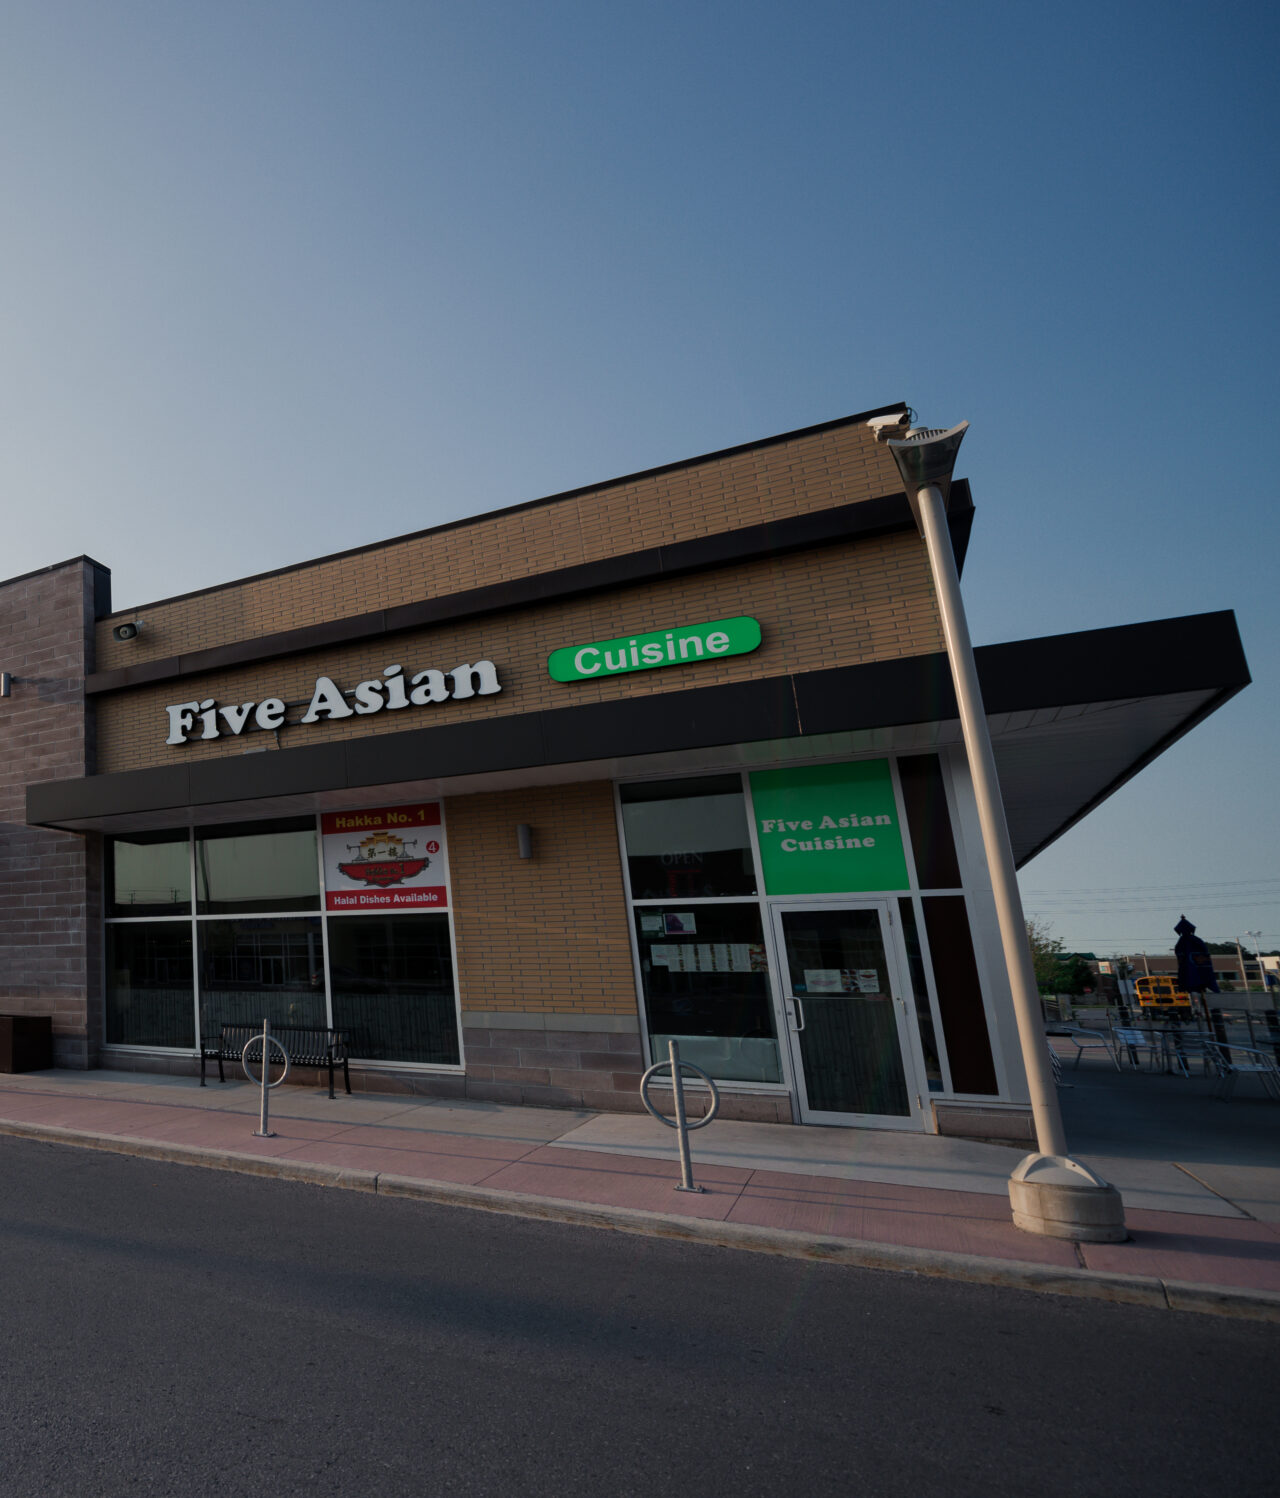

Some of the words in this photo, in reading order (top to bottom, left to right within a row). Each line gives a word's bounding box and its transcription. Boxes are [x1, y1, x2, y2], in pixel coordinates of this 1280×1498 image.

[574, 630, 730, 675] Cuisine
[165, 697, 286, 745] Five
[300, 659, 502, 724] Asian
[335, 816, 382, 828] Hakka
[386, 812, 413, 823] No.
[417, 809, 424, 820] 1
[761, 819, 813, 833] Five
[818, 813, 892, 829] Asian
[780, 836, 876, 852] Cuisine
[661, 851, 704, 865] OPEN
[334, 896, 356, 904] Halal
[360, 895, 391, 904] Dishes
[393, 893, 438, 903] Available
